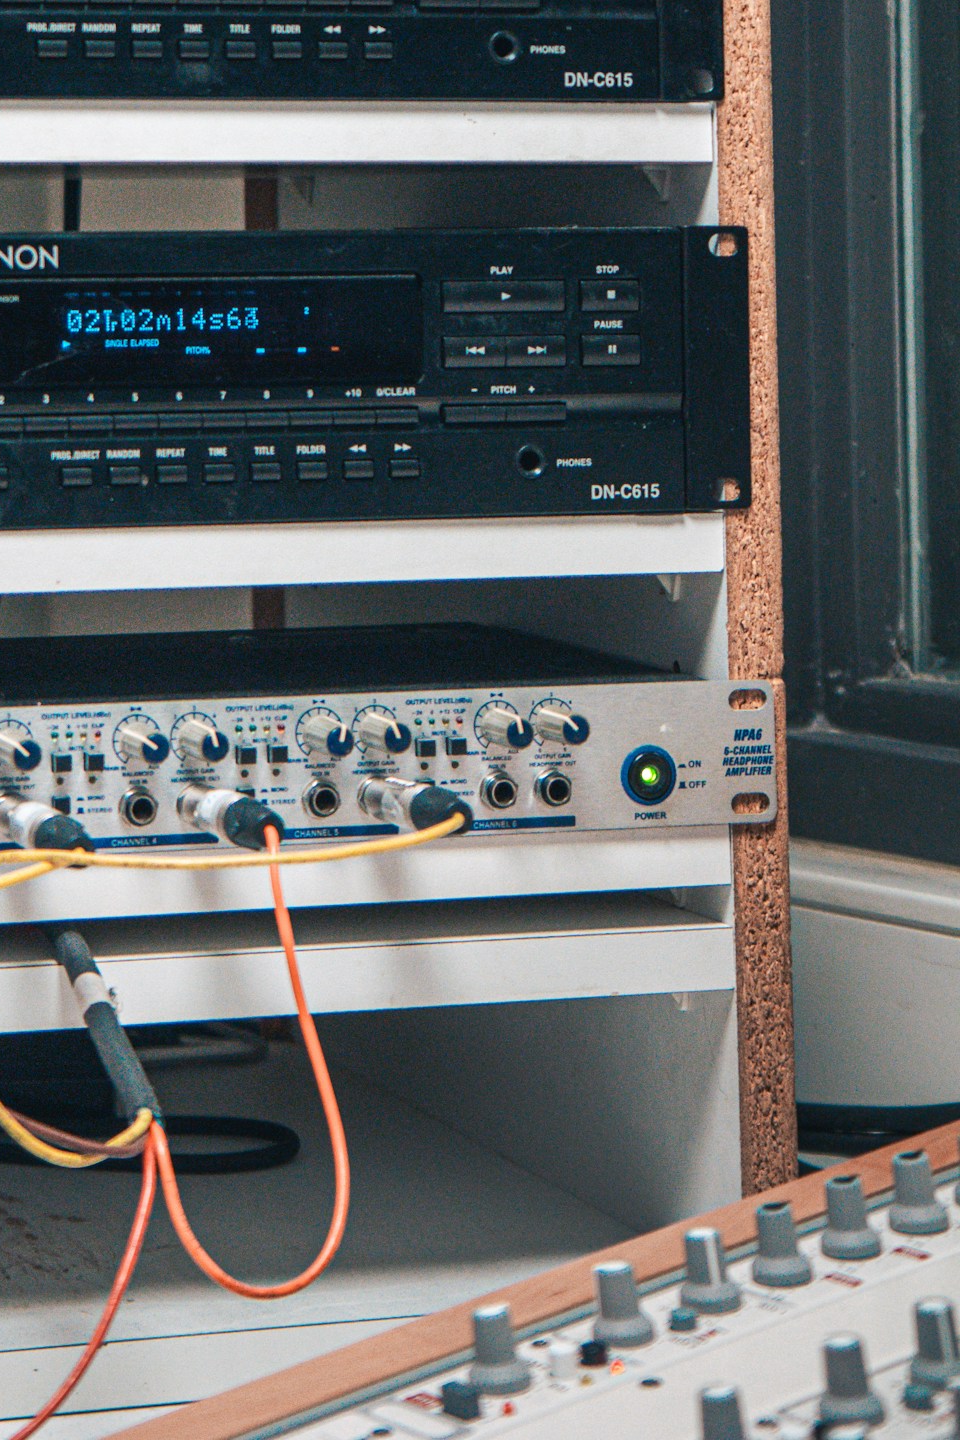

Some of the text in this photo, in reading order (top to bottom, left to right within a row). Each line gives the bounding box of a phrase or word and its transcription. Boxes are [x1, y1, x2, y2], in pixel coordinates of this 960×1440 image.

[82, 23, 116, 33] RANDOM
[132, 23, 160, 33] REPEAT
[184, 24, 202, 33] TIME
[230, 24, 250, 33] TITLE
[271, 24, 301, 34] FOLDER
[530, 45, 566, 54] PHONES
[564, 72, 633, 88] DN-C615
[490, 266, 513, 275] PLAY
[596, 265, 619, 274] STOP
[594, 320, 623, 329] PAUSE
[105, 339, 159, 348] SINGLE ELAPSED
[307, 389, 314, 398] 9
[345, 388, 362, 398] +10
[491, 385, 516, 394] PITCH
[42, 394, 50, 404] 3
[87, 393, 94, 402] 4
[132, 392, 139, 402] 5
[175, 391, 183, 401] 6
[220, 390, 226, 400] 7
[263, 390, 270, 399] 8
[106, 449, 140, 459] RANDOM
[156, 448, 185, 458] REPEAT
[209, 447, 227, 457] TIME
[255, 446, 275, 455] TITLE
[296, 445, 326, 454] FOLDER
[557, 458, 592, 467] PHONES
[591, 483, 660, 500] DN-C615
[734, 729, 762, 741] HPA6
[724, 745, 772, 755] 6-CHANNEL
[722, 755, 774, 766] HEADPHONE
[725, 766, 772, 777] AMPLIFIER
[635, 812, 667, 820] POWER
[295, 829, 332, 837] CHANNEL
[112, 838, 149, 846] CHANNEL
